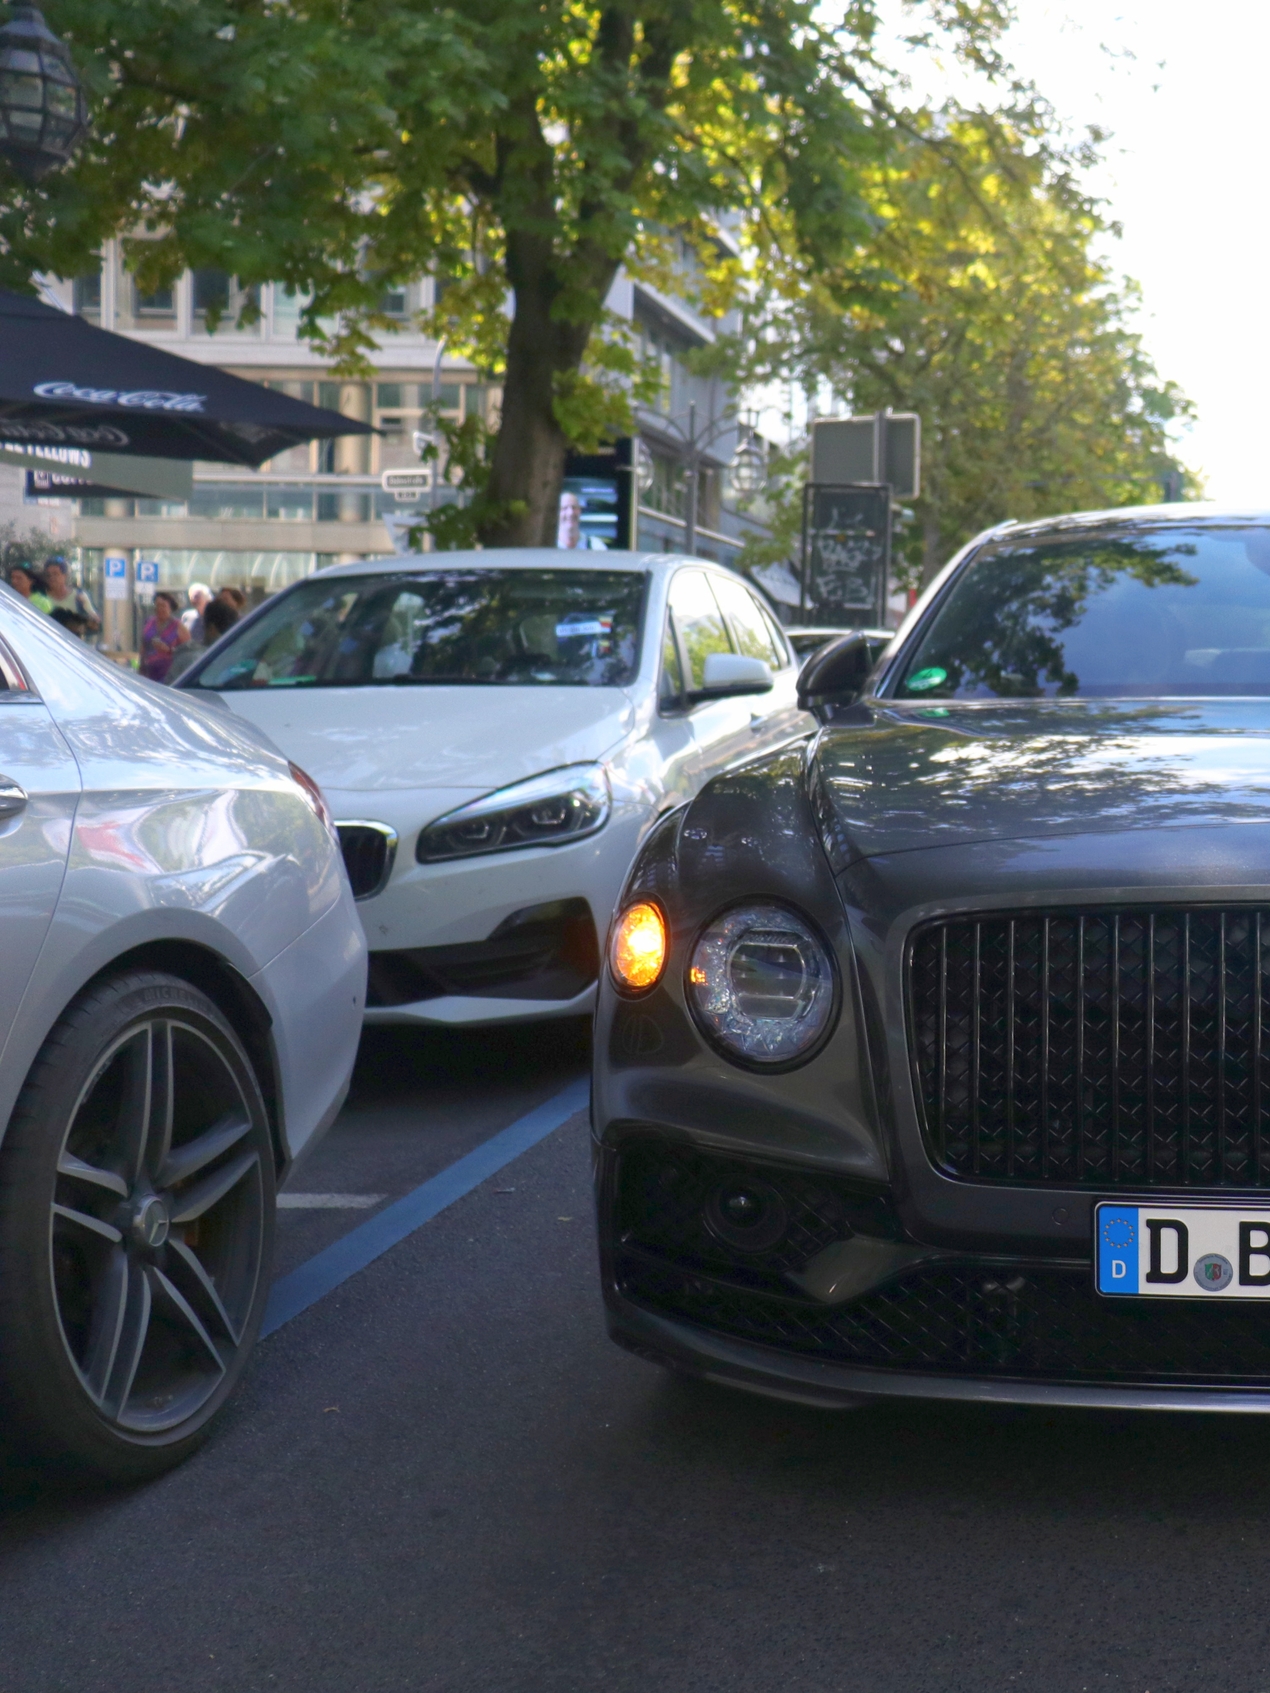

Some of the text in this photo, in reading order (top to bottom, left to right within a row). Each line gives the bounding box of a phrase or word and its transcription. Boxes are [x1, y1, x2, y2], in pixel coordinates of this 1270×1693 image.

[33, 382, 207, 412] Coca-Cola
[1145, 1218, 1189, 1284] D
[1113, 1260, 1126, 1279] D
